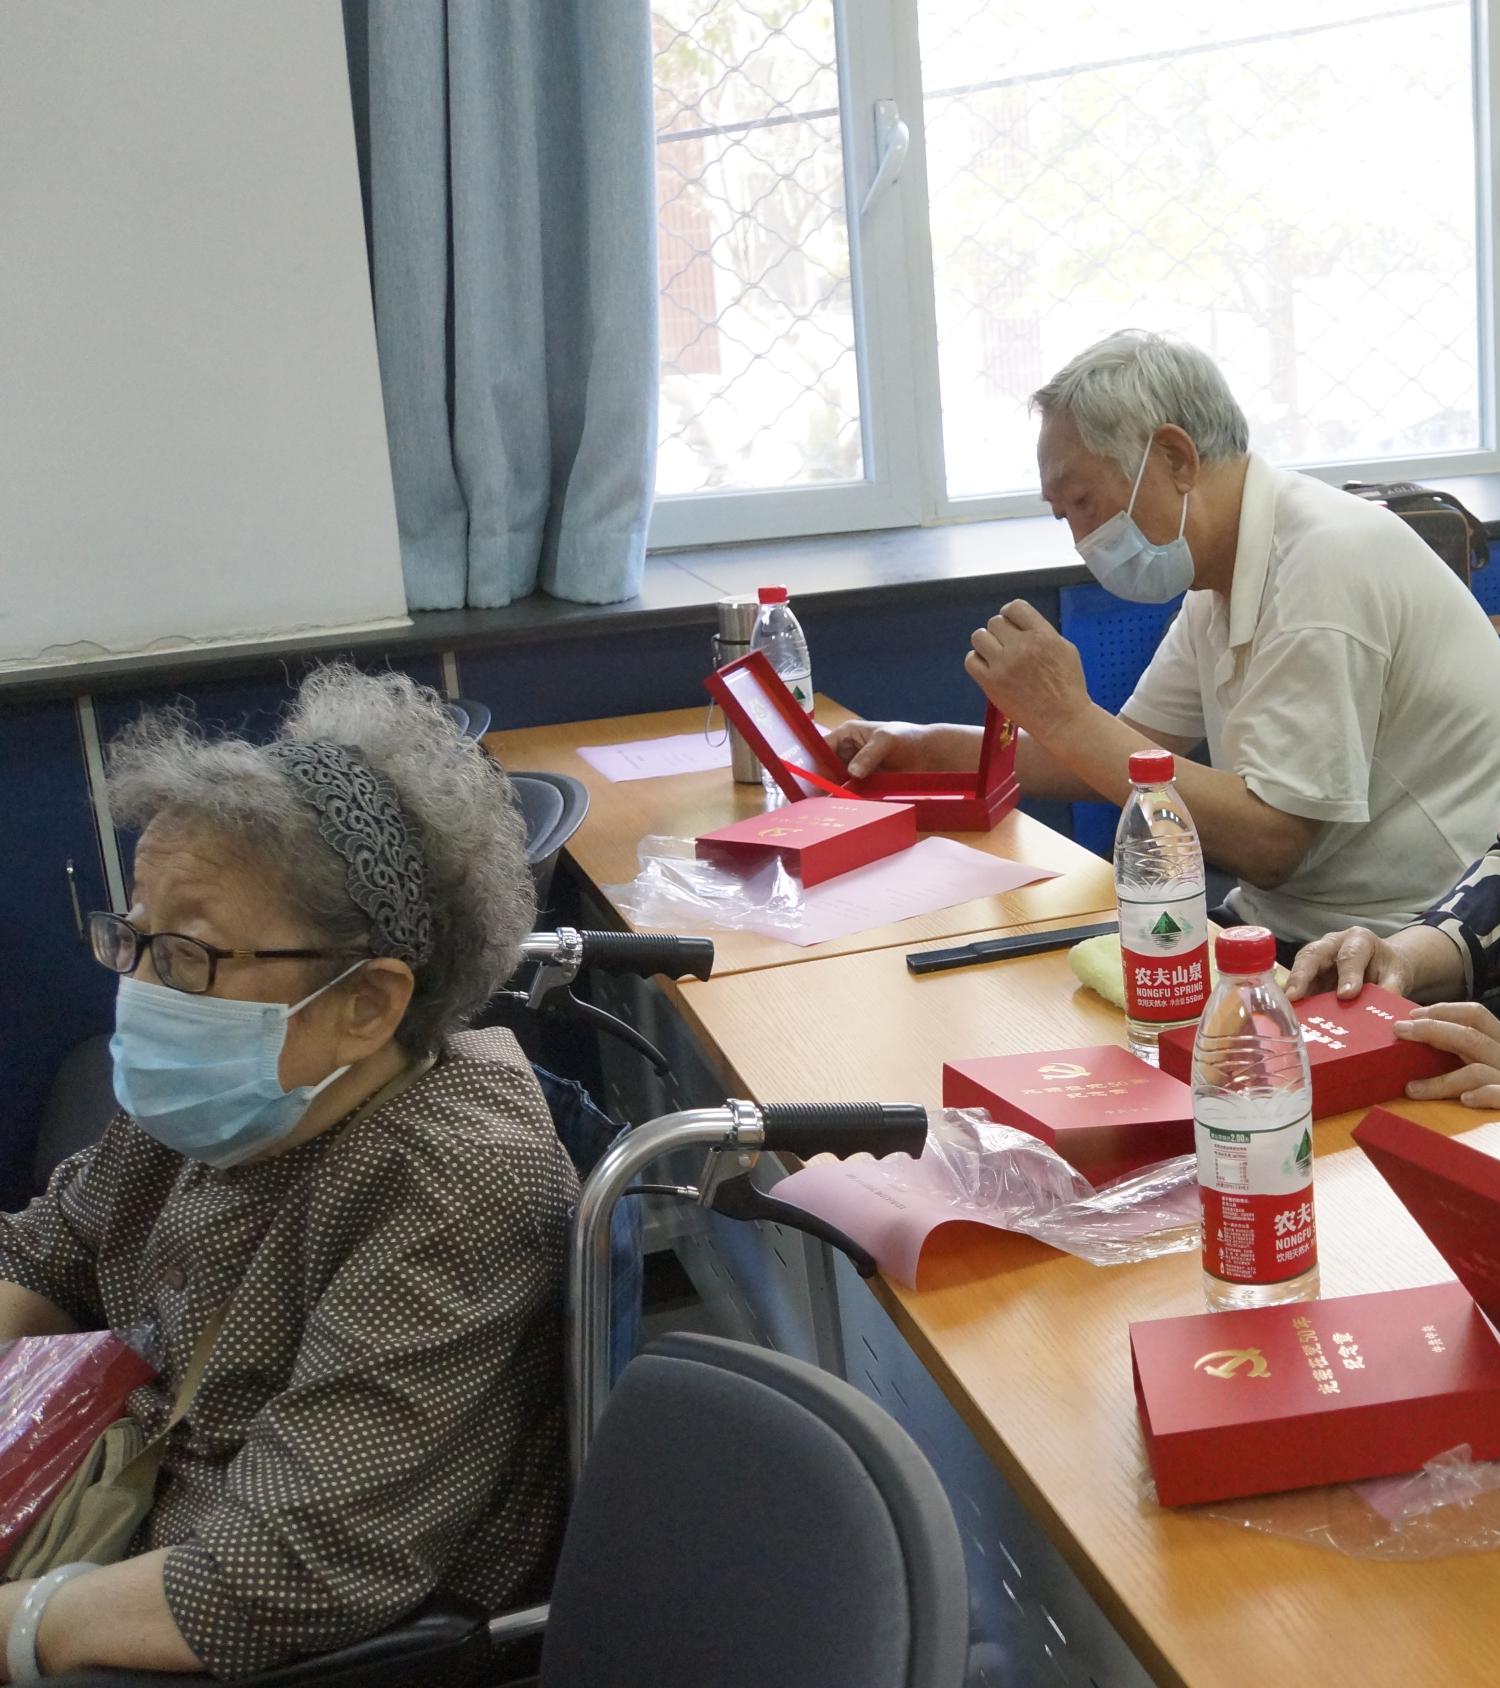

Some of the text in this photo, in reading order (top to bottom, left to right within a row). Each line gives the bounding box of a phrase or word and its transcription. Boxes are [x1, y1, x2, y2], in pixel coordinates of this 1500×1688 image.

[1135, 962, 1202, 986] 农夫山泉
[1137, 981, 1203, 998] NONGFU SPRING
[1274, 1202, 1314, 1236] 农夫
[1275, 1225, 1311, 1251] NONGFU
